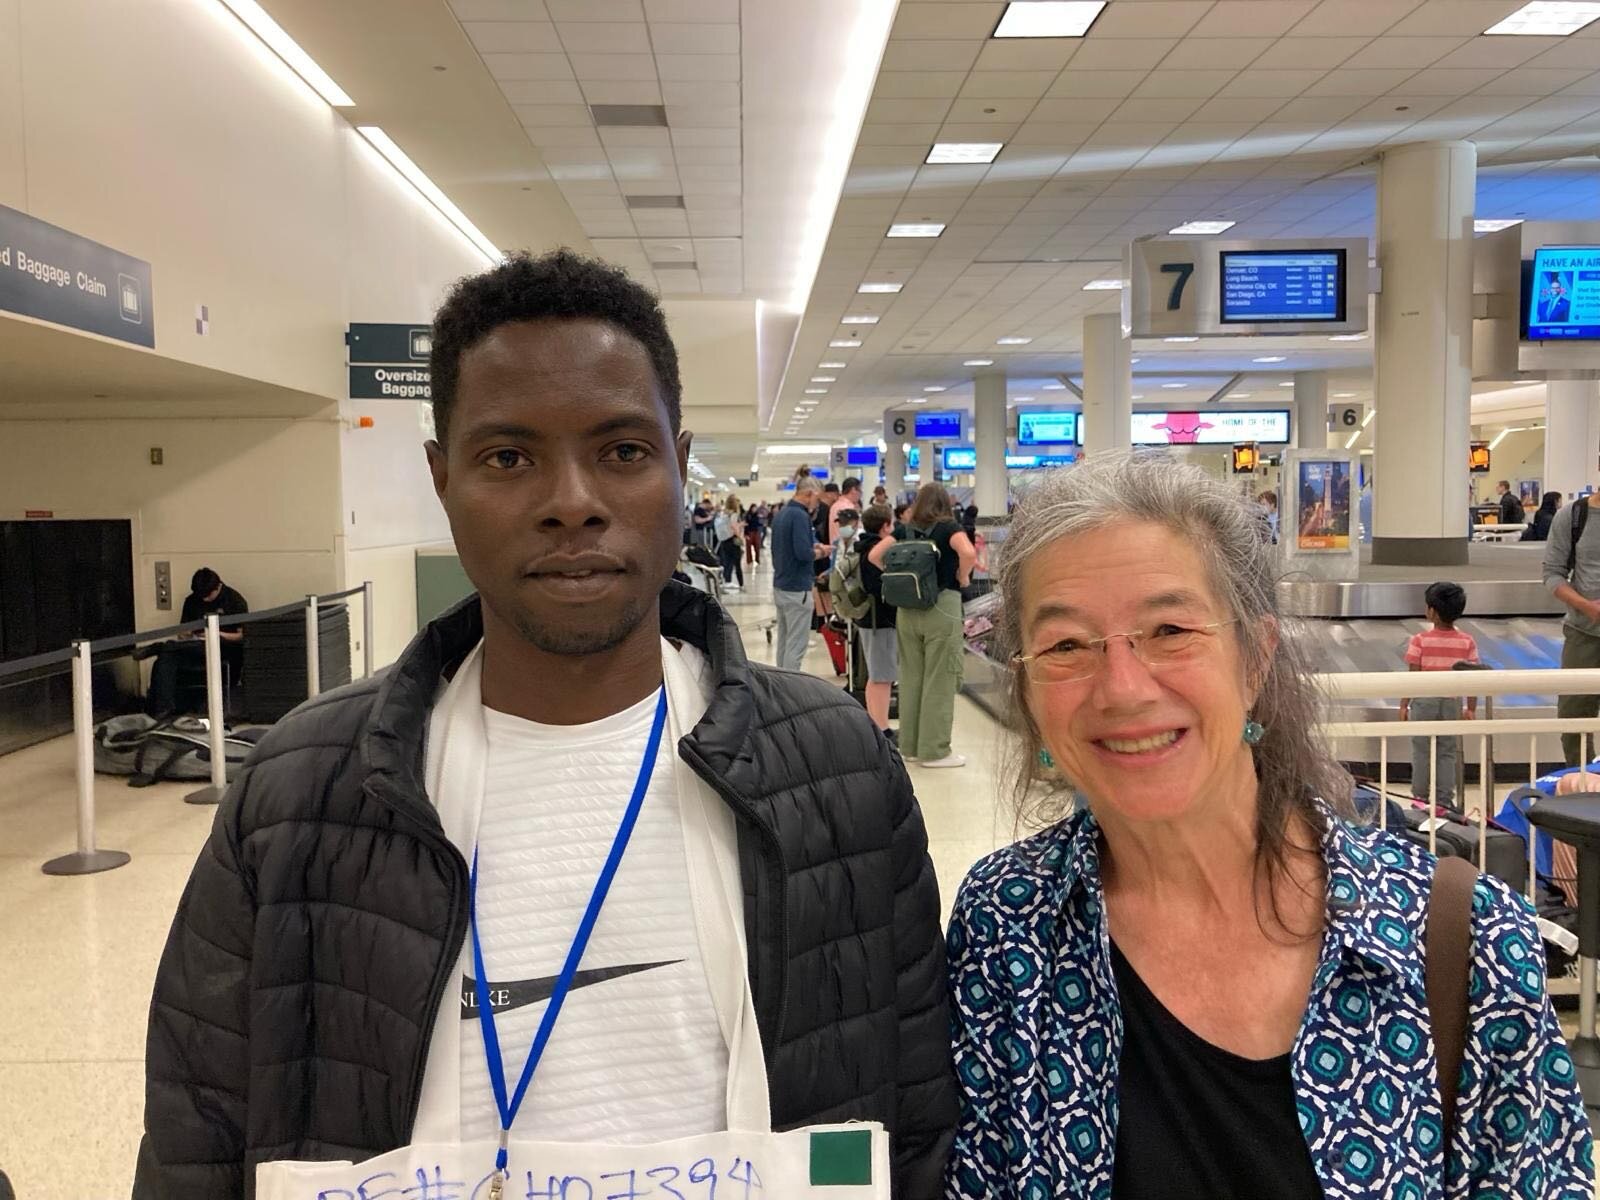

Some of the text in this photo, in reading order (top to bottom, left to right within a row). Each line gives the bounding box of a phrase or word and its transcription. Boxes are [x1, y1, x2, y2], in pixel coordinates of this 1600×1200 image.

[1542, 258, 1568, 267] HAVE
[1570, 258, 1584, 267] AN
[17, 251, 71, 287] Baggage
[77, 271, 107, 297] Claim
[1160, 262, 1194, 311] 7
[375, 369, 431, 382] Oversize
[382, 382, 431, 397] Baggag
[1342, 408, 1357, 426] 6
[893, 418, 906, 435] 6
[835, 451, 844, 463] 5
